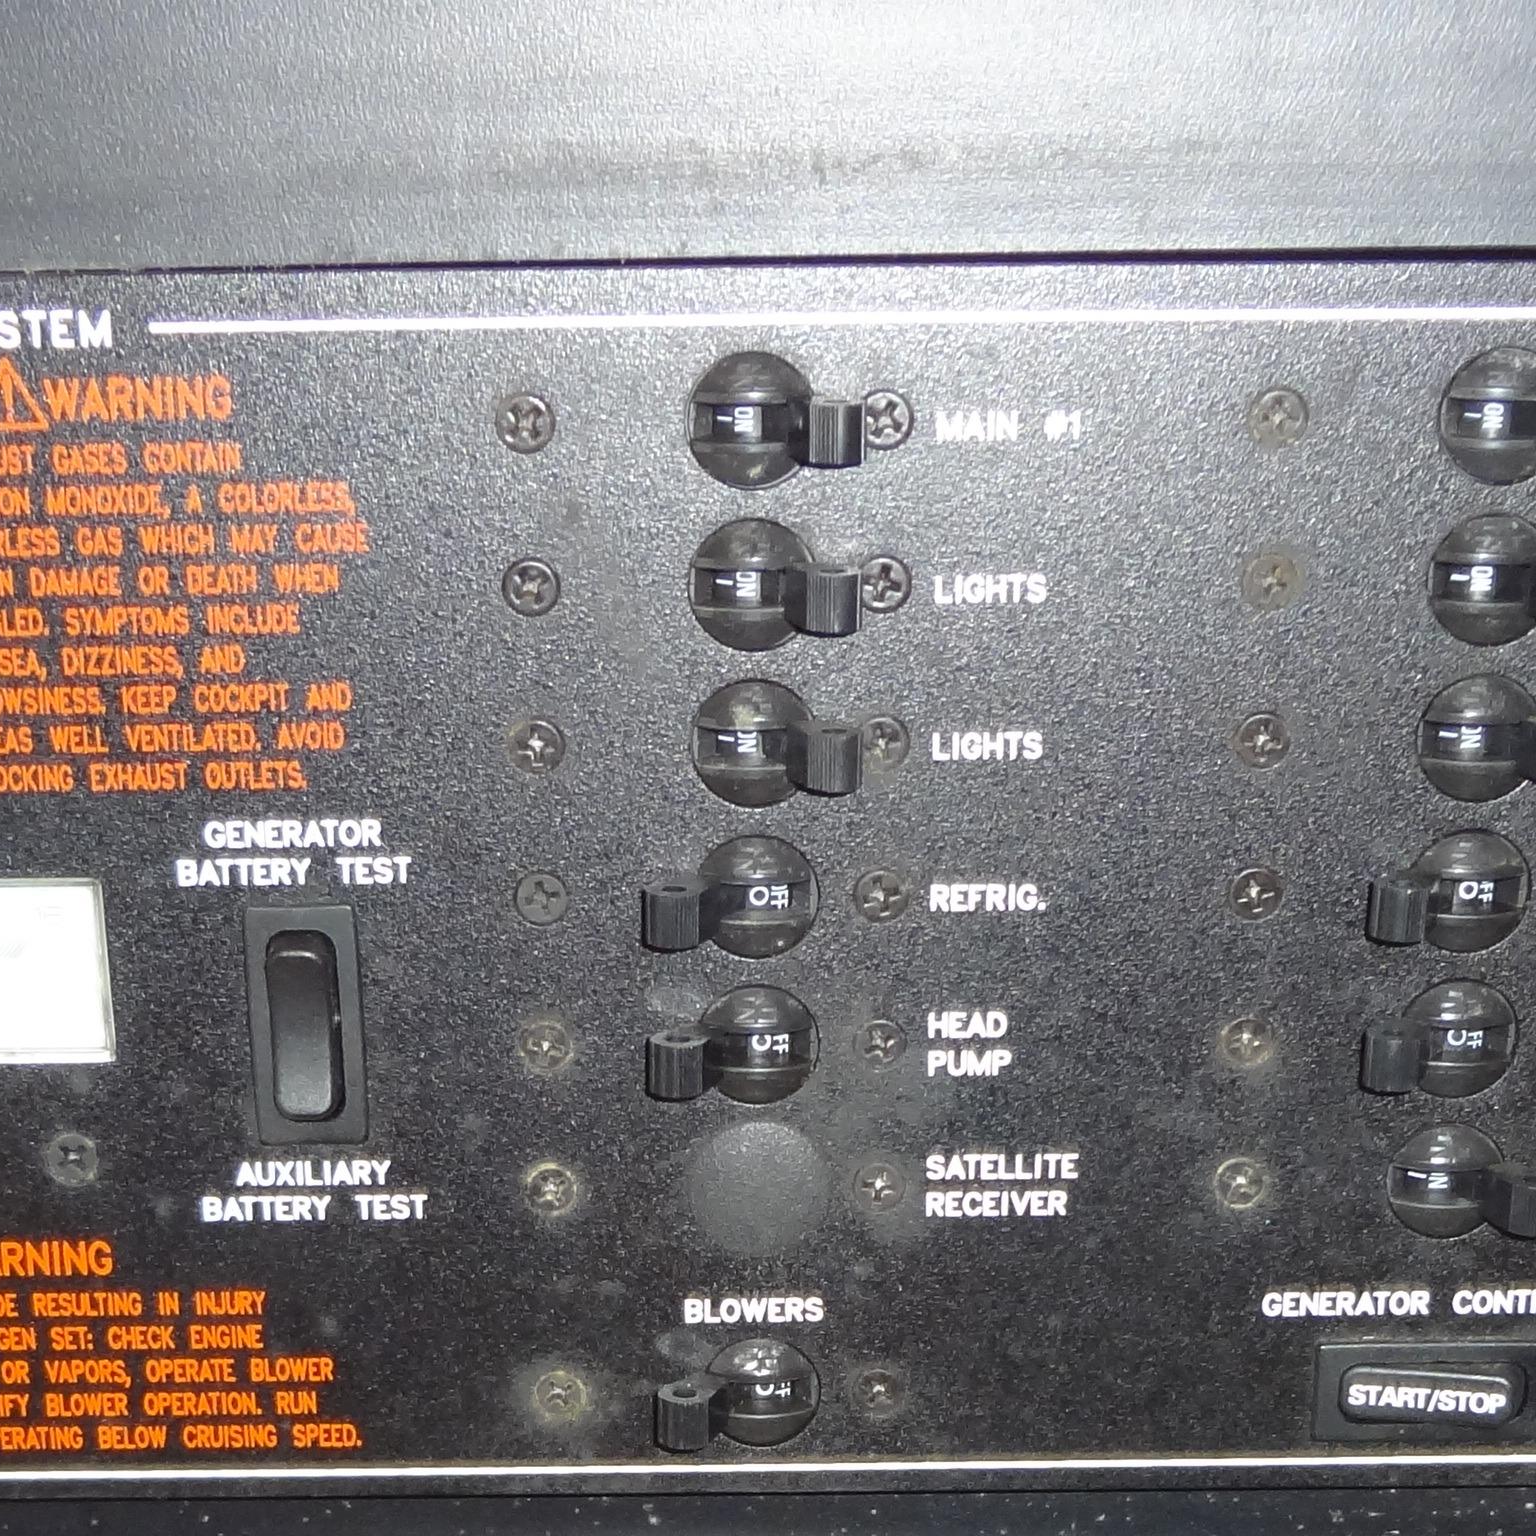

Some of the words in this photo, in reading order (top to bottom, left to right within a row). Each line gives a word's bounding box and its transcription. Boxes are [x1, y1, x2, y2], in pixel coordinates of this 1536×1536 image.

[42, 374, 231, 422] WARNING
[933, 411, 1019, 443] MAIN
[1043, 411, 1084, 441] #1
[50, 442, 128, 476] GASES
[142, 440, 241, 474] CONTAIN
[43, 482, 171, 520] MONOXIDE,
[186, 486, 203, 513] A
[218, 481, 355, 516] COLORLESS,
[931, 571, 1053, 606] LIGHTS
[931, 727, 1044, 761] LIGHTS
[87, 760, 188, 792] EXHAUST
[203, 758, 307, 791] OUTLETS.
[203, 816, 386, 849] GENERATOR
[175, 857, 312, 887] BATTERY
[334, 855, 412, 885] TEST
[929, 881, 1047, 913] REFRIG.
[927, 1010, 1008, 1041] HEAD
[927, 1048, 1013, 1077] PUMP
[235, 1159, 392, 1187] AUXILIARY
[925, 1152, 1080, 1181] SATELLITE
[201, 1194, 332, 1222] BATTERY
[354, 1193, 428, 1221] TEST
[925, 1189, 1068, 1218] RECEIVER
[30, 1290, 143, 1318] RESULTING
[156, 1291, 181, 1316] IN
[194, 1288, 265, 1317] INJURY
[683, 1296, 824, 1324] BLOWERS
[1261, 1290, 1431, 1318] GENERATOR
[48, 1323, 93, 1352] SET:
[106, 1323, 176, 1351] CHECK
[187, 1322, 262, 1351] ENGINE
[1347, 1383, 1507, 1415] START/STOP
